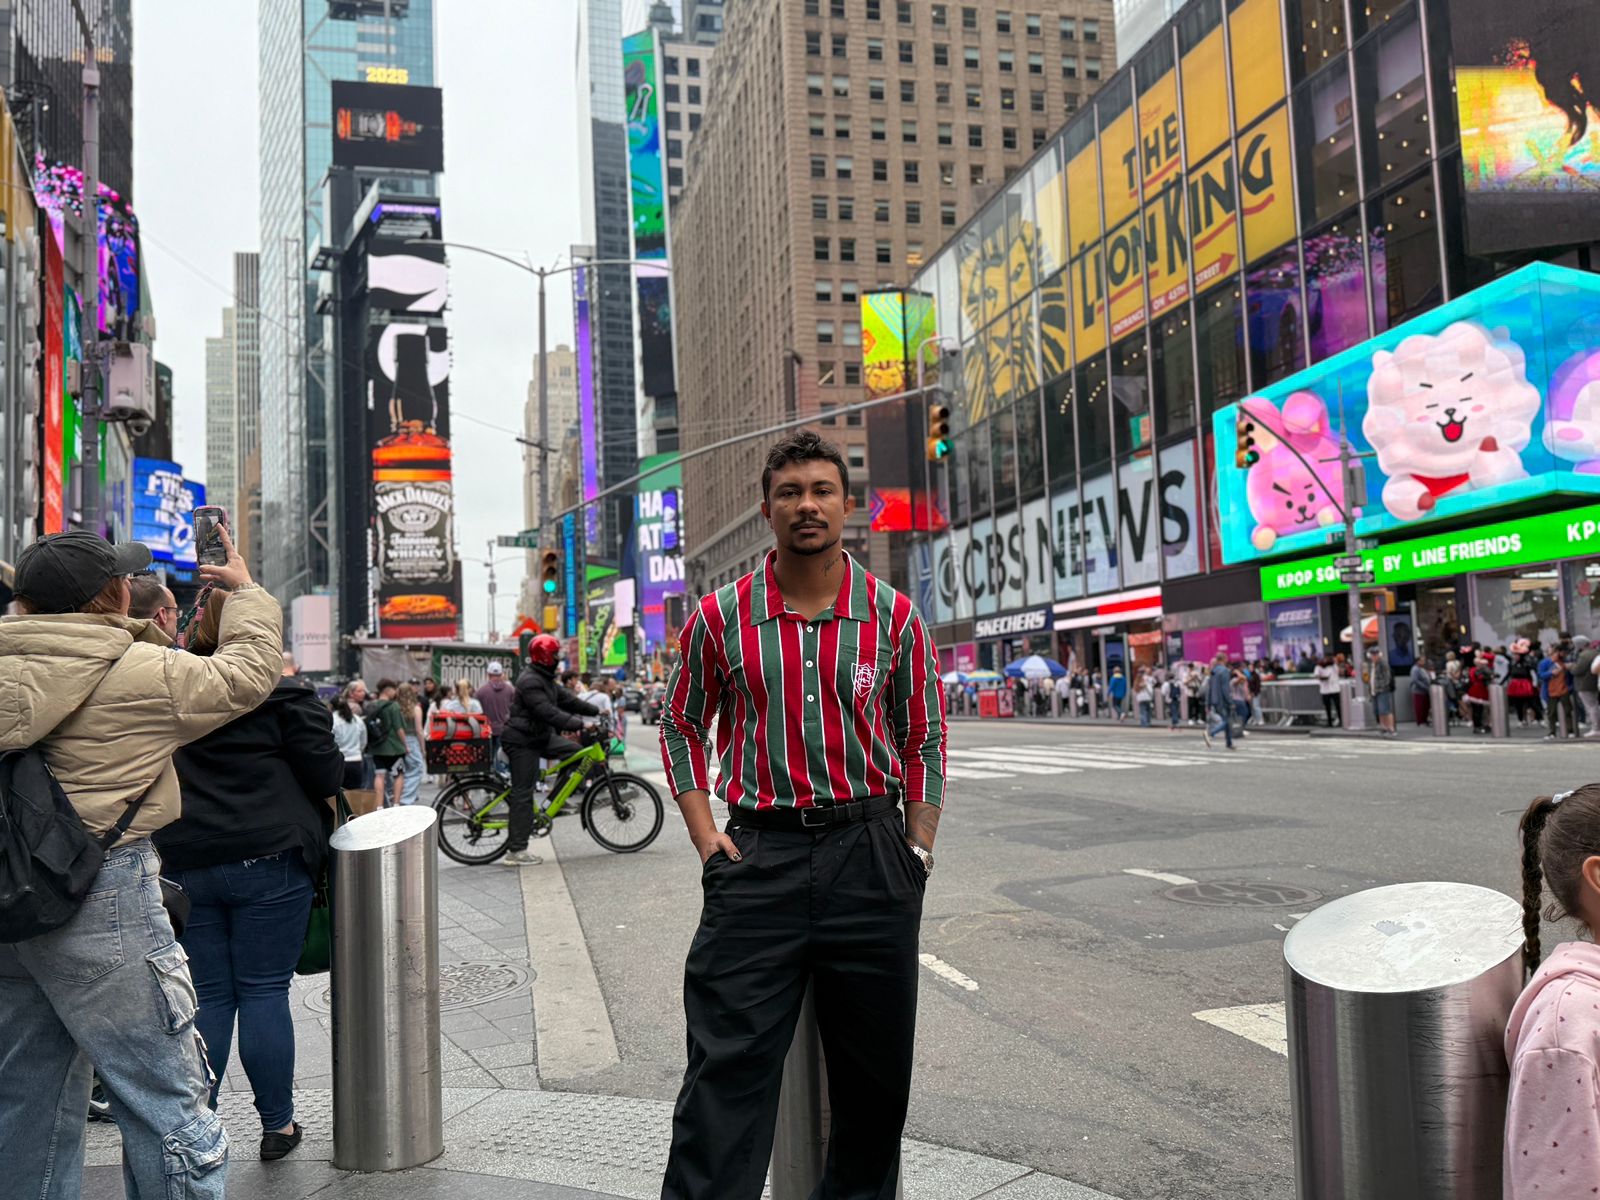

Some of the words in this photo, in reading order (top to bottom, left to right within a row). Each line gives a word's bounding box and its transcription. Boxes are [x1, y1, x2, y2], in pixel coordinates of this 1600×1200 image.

[1123, 111, 1180, 190] THE
[1079, 211, 1158, 330] LION
[1161, 133, 1274, 276] KING
[1152, 295, 1166, 310] ON
[1195, 261, 1220, 287] STREET
[375, 489, 406, 513] JACK
[387, 548, 444, 559] WHISKEY
[963, 525, 1028, 600] CBS
[1036, 470, 1190, 585] NEWS
[1277, 569, 1313, 588] KPOP
[1383, 554, 1402, 572] BY
[1412, 546, 1448, 568] LINE
[1450, 533, 1522, 562] FRIENDS
[1567, 520, 1600, 542] KP
[649, 555, 686, 583] DAY
[975, 609, 1047, 638] SKECHERS
